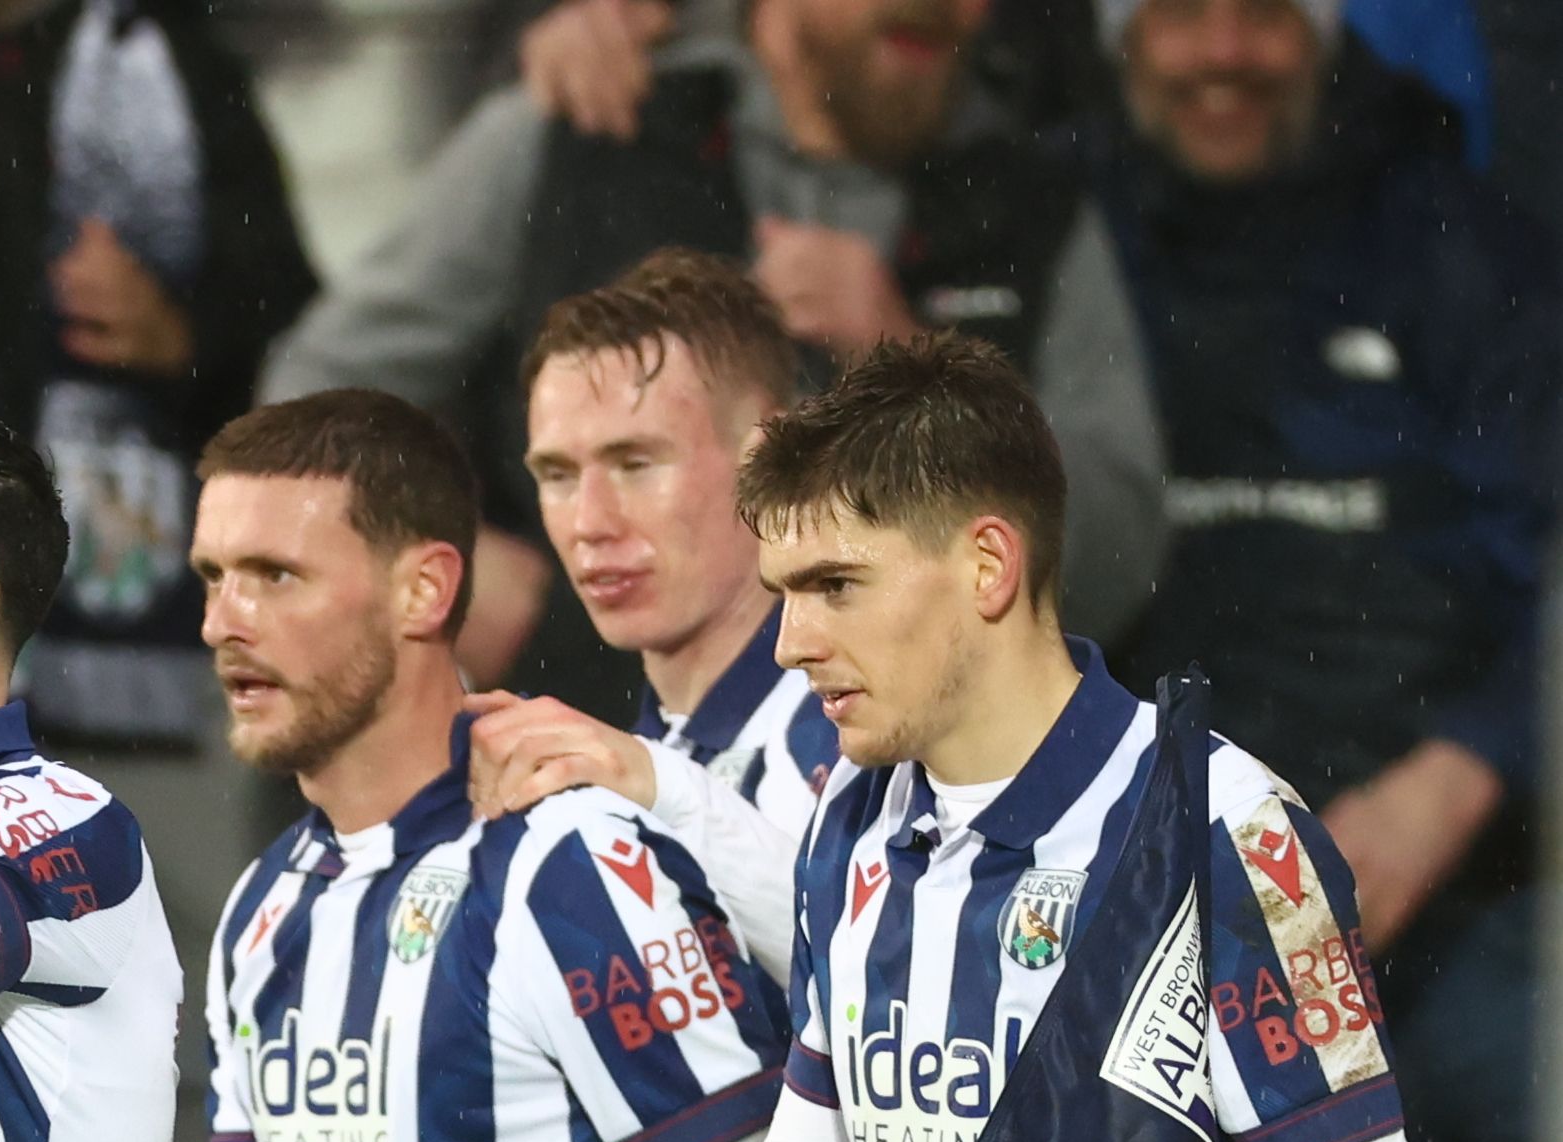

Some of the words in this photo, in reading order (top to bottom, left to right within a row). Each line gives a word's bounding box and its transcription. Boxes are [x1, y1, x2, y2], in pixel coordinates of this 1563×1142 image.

[1017, 881, 1077, 901] ALBION
[565, 915, 739, 1018] BARBE
[609, 962, 744, 1052] BOSS
[1210, 928, 1372, 1033] BARBE
[239, 1014, 391, 1117] ideal
[847, 1004, 1013, 1119] ideal
[1123, 1010, 1167, 1071] WEST
